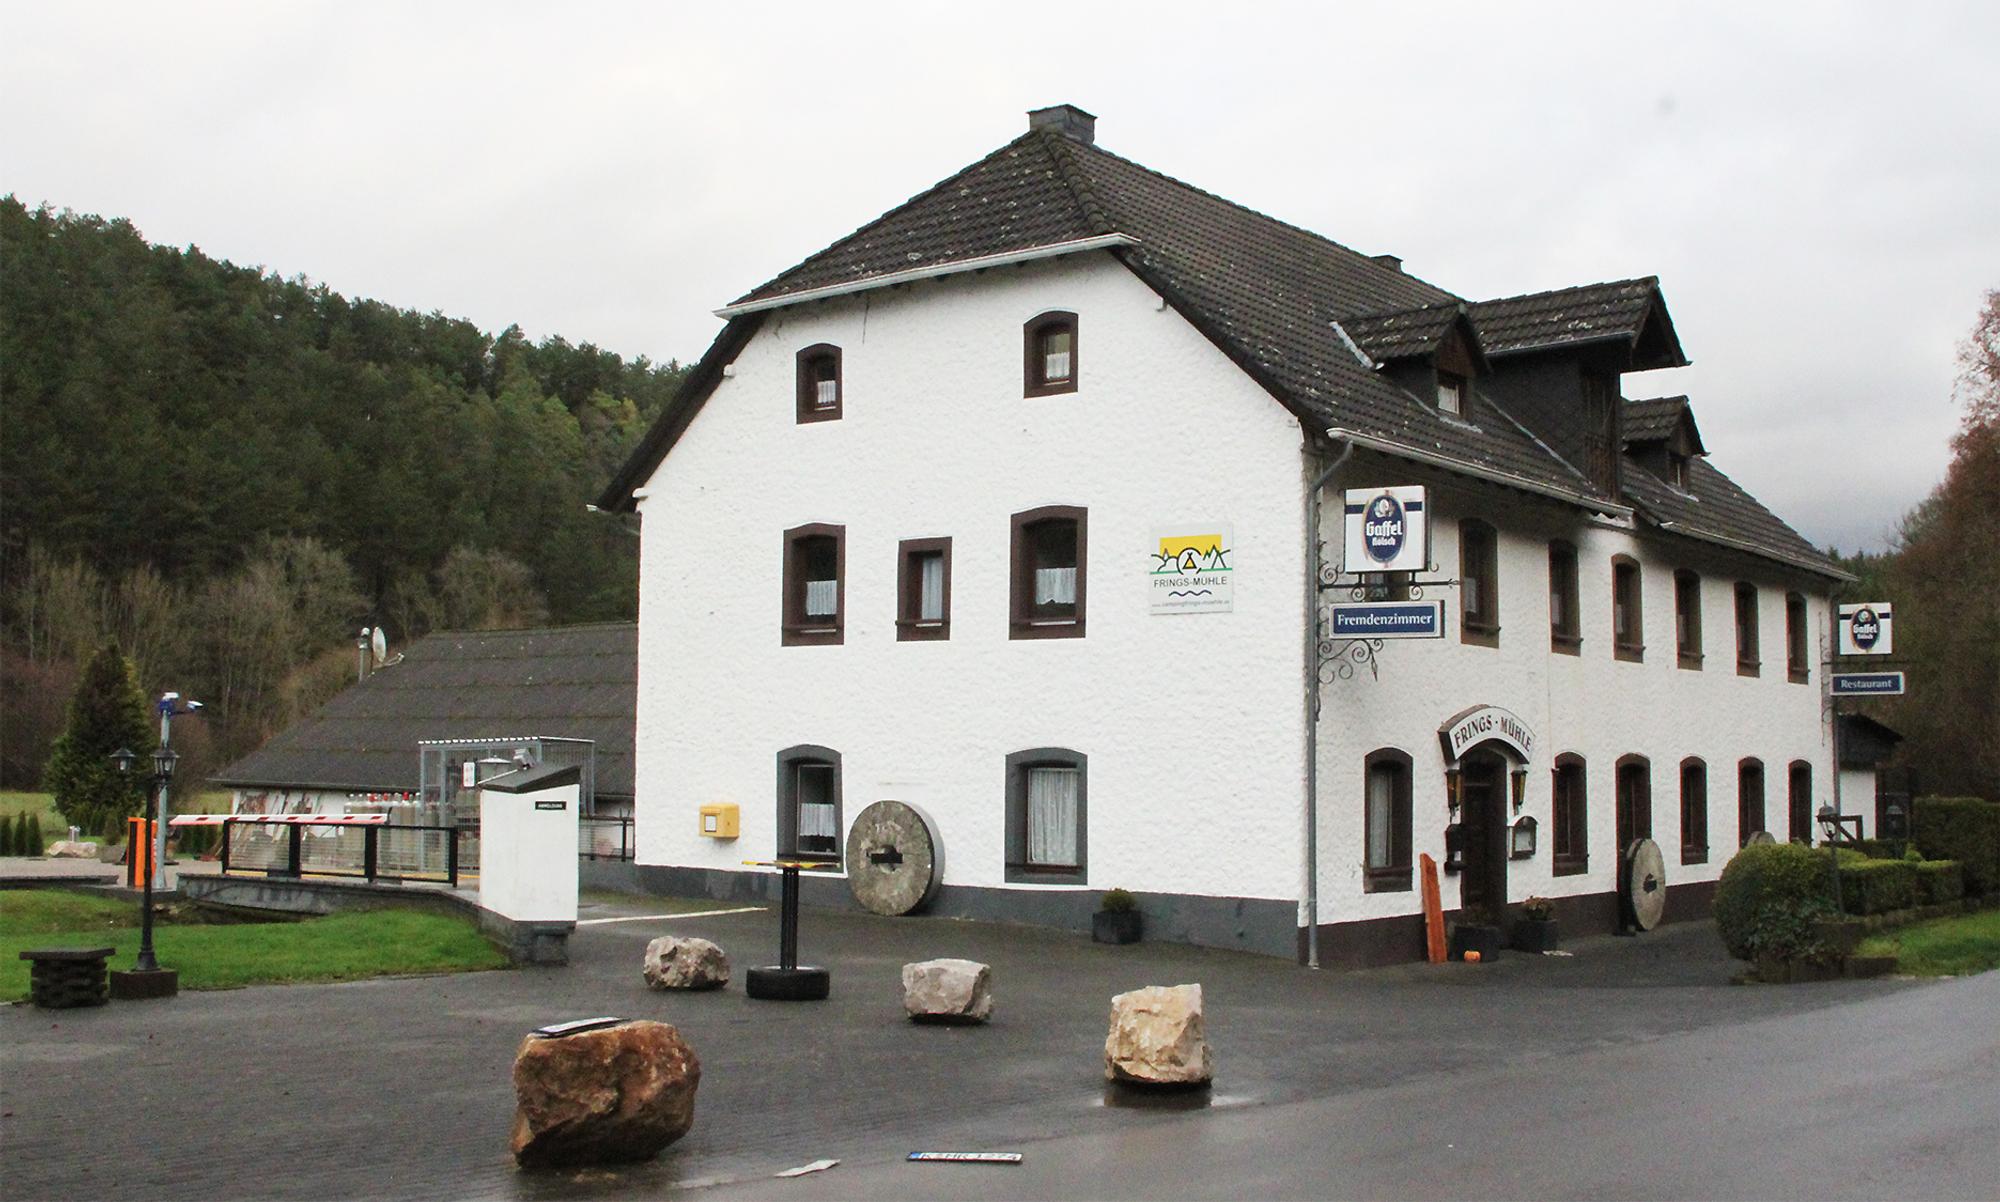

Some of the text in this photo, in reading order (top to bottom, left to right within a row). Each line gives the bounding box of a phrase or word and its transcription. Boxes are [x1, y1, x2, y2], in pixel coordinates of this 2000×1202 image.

[1366, 520, 1403, 537] Gaffel
[1337, 613, 1433, 626] Fremdenzimmer
[1853, 623, 1878, 633] Gaffel
[1840, 679, 1893, 688] Restaurant
[1454, 714, 1532, 753] FRINGS MÜHLE
